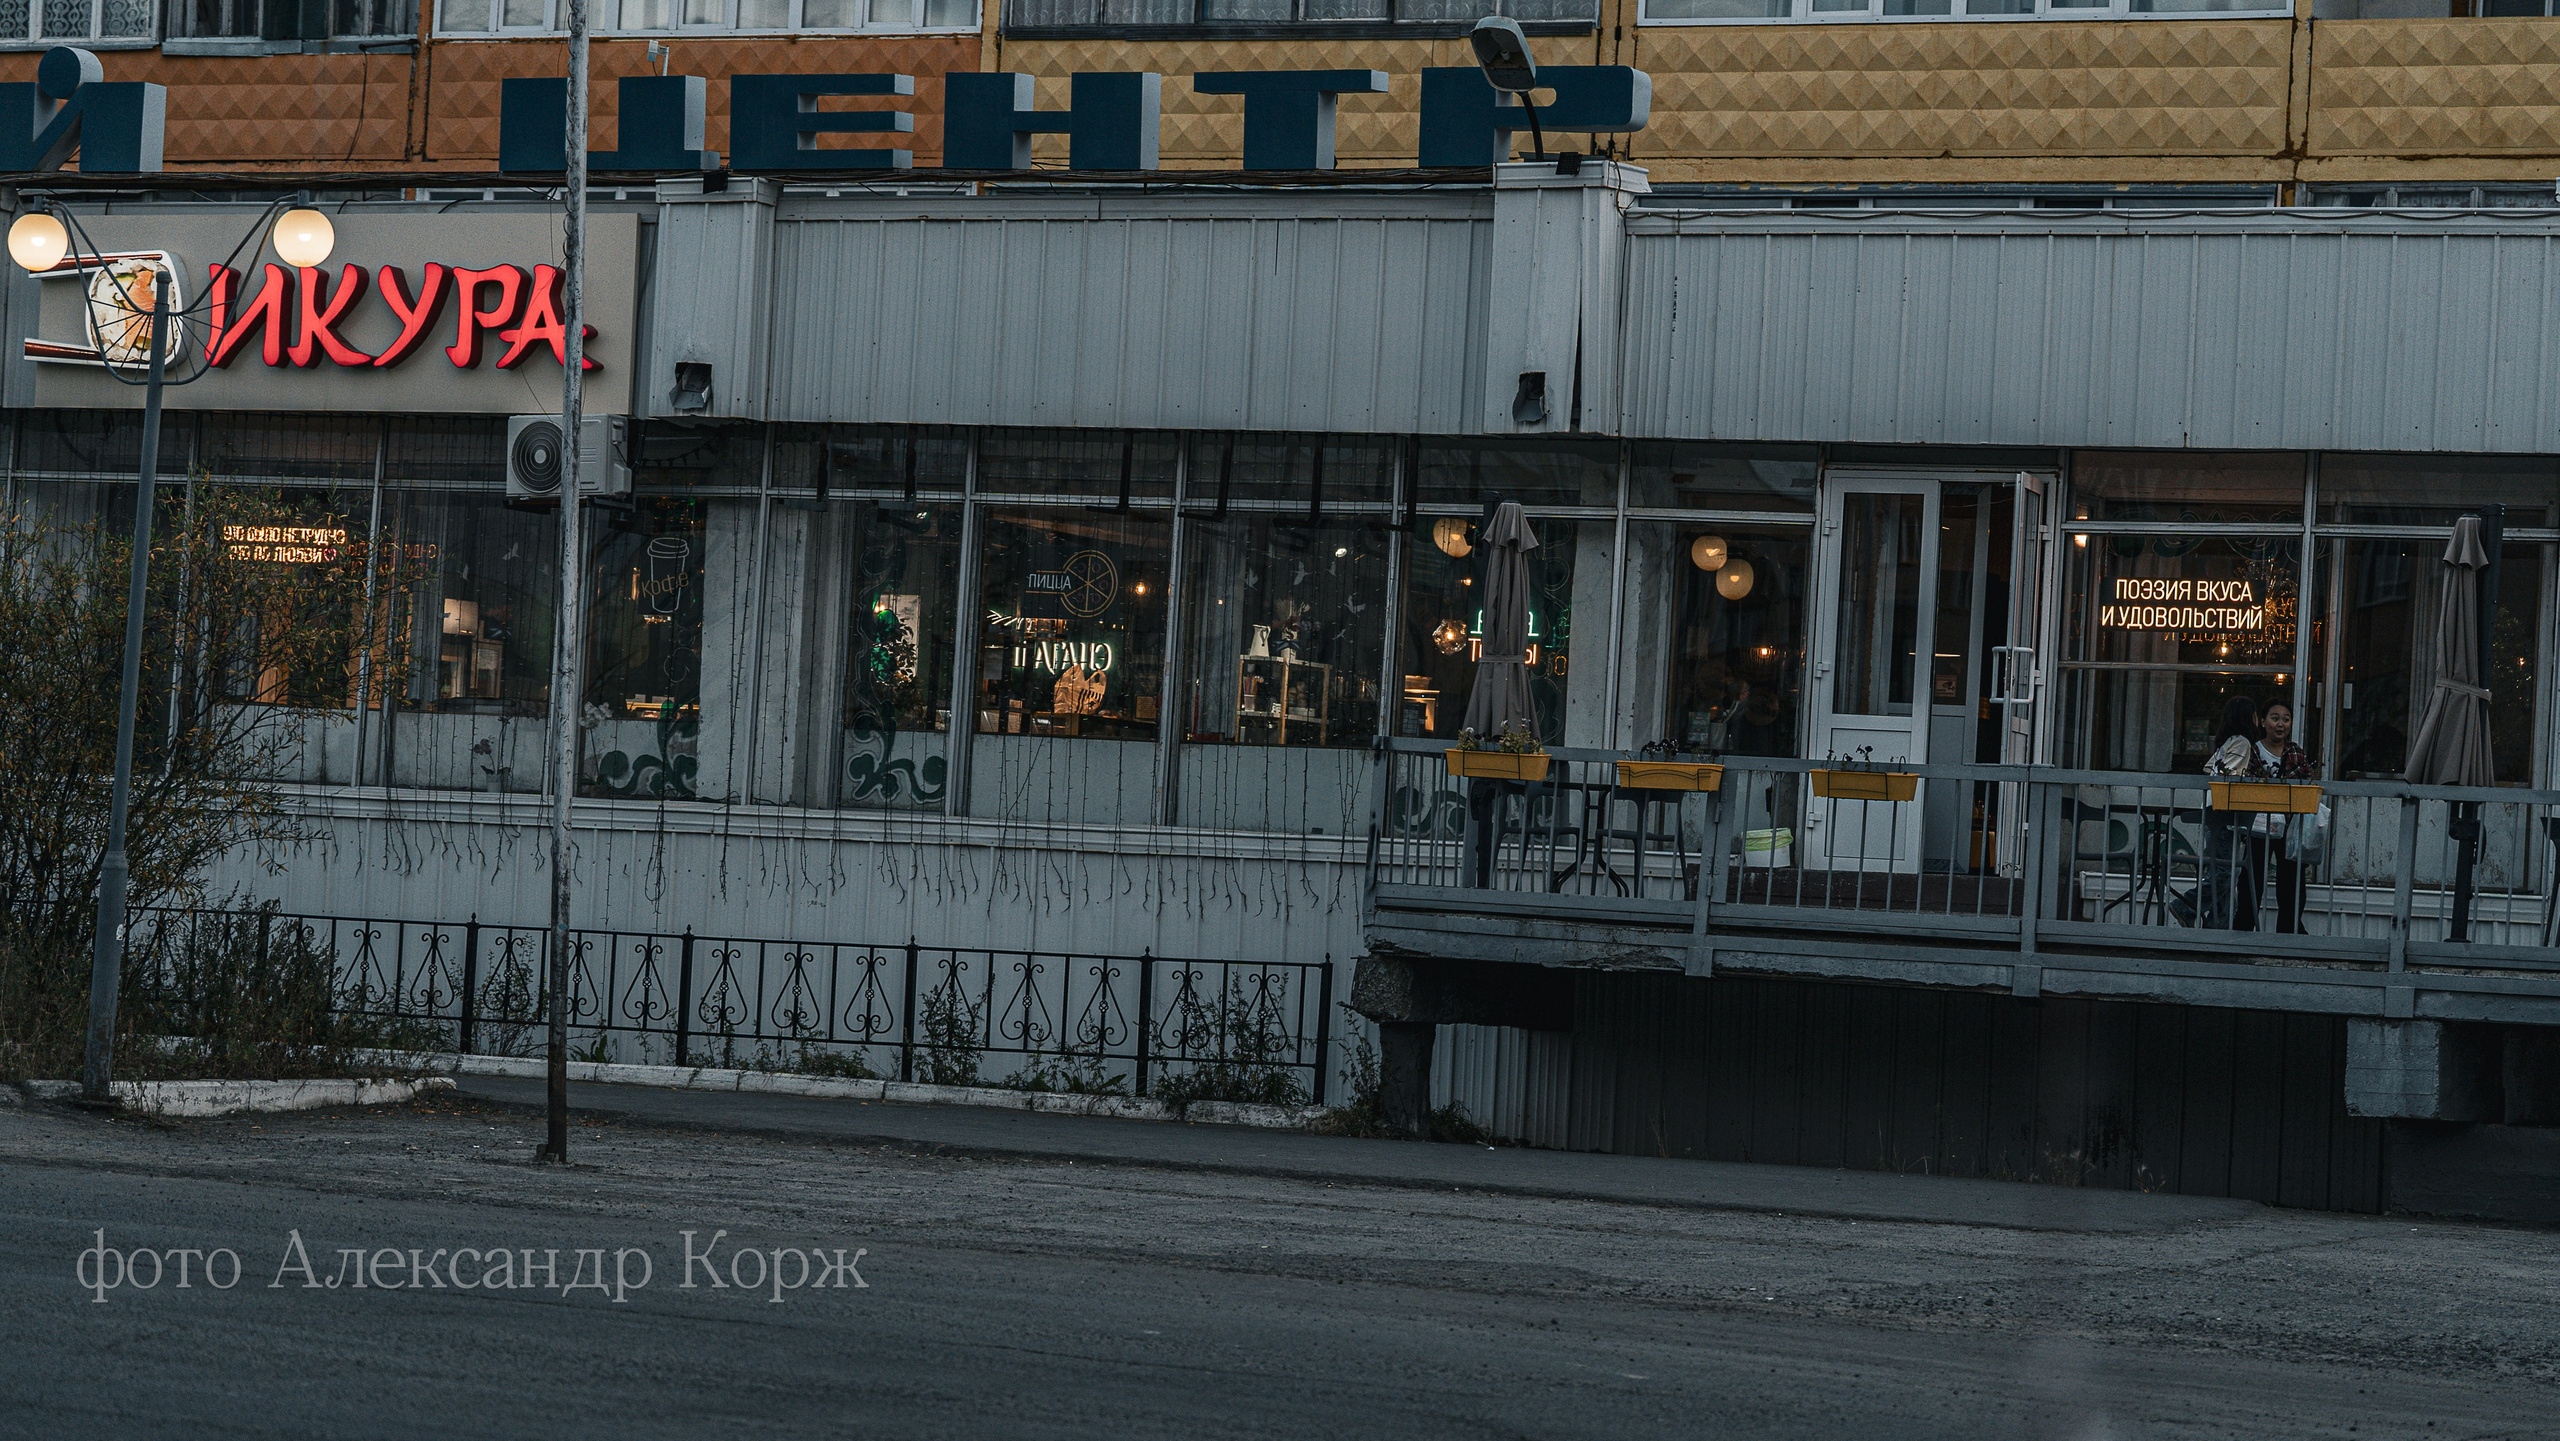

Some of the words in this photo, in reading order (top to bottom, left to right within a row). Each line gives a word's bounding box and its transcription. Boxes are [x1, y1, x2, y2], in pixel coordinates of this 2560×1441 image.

[500, 65, 1651, 172] ЦЕНТР
[204, 262, 605, 371] ИКУРА
[1028, 573, 1072, 591] ПИЦЦА
[2115, 578, 2192, 601] ПОЭЗИЯ
[2196, 579, 2253, 603] ВКУСА
[2101, 605, 2114, 627] И
[2117, 604, 2263, 631] УДОВОЛЬСТВИЙ
